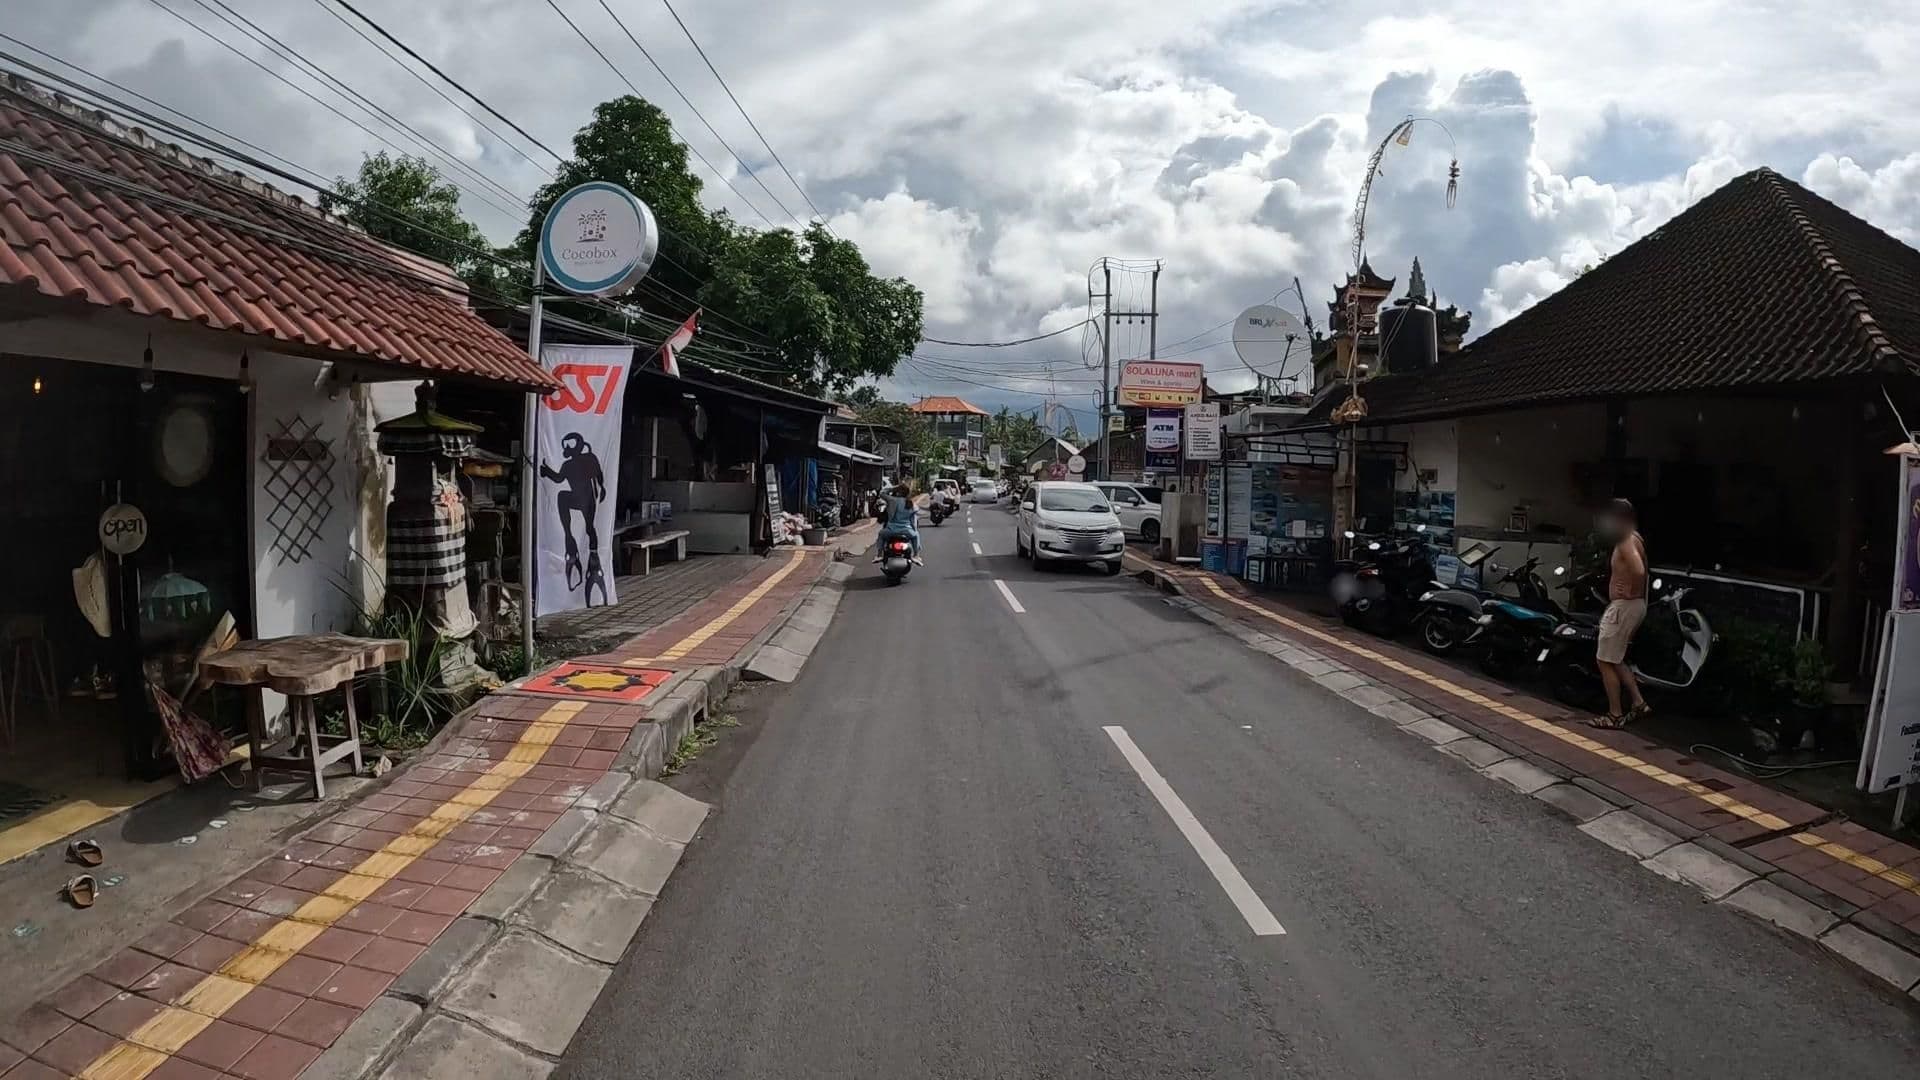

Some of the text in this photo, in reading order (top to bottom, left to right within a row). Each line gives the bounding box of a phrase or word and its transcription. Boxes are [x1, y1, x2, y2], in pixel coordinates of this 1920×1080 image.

[561, 245, 617, 260] Cocobox
[1126, 366, 1197, 378] SOLALUNA mart
[103, 519, 143, 544] open
